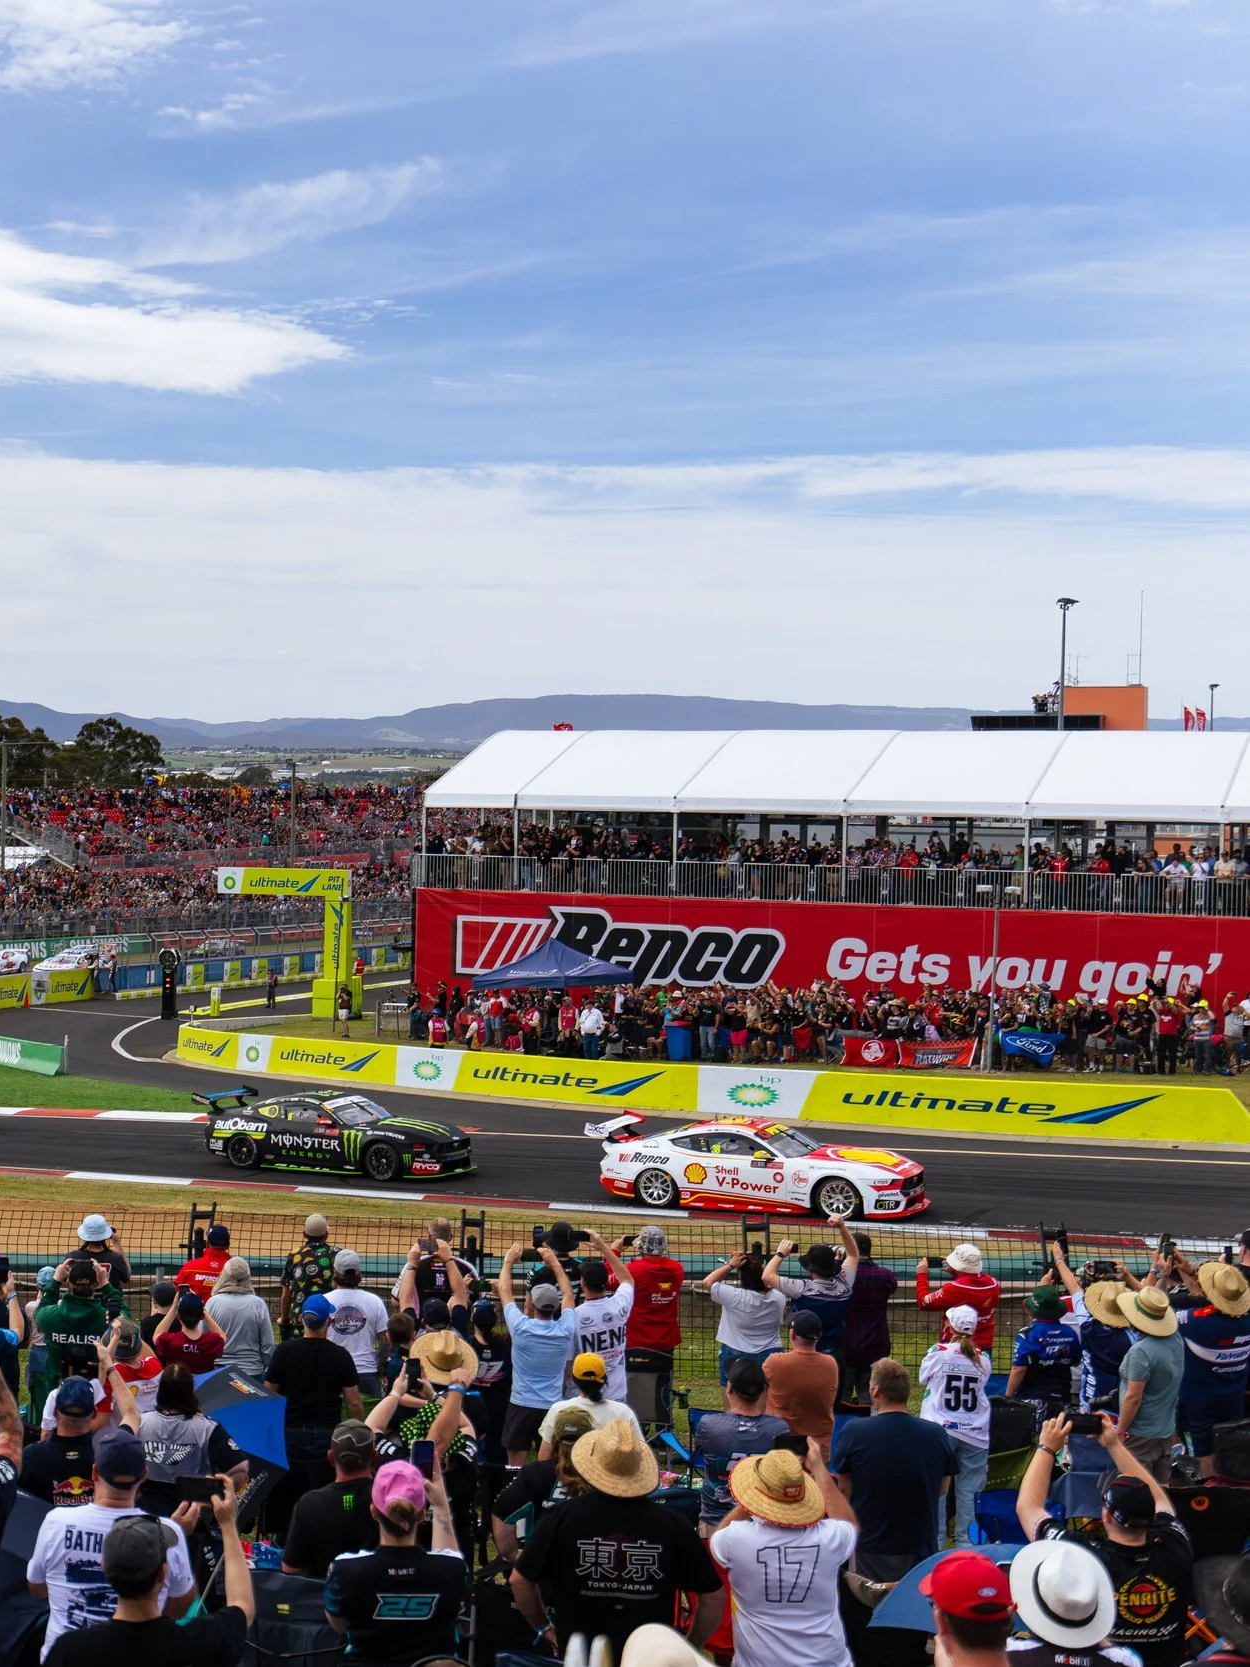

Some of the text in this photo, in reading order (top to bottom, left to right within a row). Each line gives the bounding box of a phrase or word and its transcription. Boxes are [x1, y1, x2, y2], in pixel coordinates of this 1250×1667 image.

[250, 877, 299, 889] ultimate
[327, 875, 340, 883] PIT
[321, 883, 343, 891] LANE
[549, 905, 786, 990] Repco
[826, 937, 1223, 1001] Gets you goin'
[51, 980, 79, 994] ultimate
[182, 1037, 214, 1052] ultimate
[1016, 1038, 1048, 1054] Ford
[279, 1048, 346, 1067] ultimate
[431, 1053, 444, 1062] bp
[473, 1065, 598, 1090] ultimate
[759, 1075, 781, 1085] bp
[841, 1089, 1057, 1117] ultimate
[270, 1132, 340, 1152] MONSTER
[281, 1149, 331, 1159] ENERGY
[630, 1152, 670, 1165] Repco
[412, 1162, 440, 1171] RYCO
[715, 1165, 739, 1176] Shell
[716, 1175, 779, 1194] V-Power
[876, 1200, 897, 1210] OTR
[195, 1274, 219, 1283] SUPERC
[182, 1343, 200, 1353] CAL
[943, 1374, 980, 1413] 55
[53, 1493, 95, 1505] Red Bu
[575, 1537, 663, 1581] 東京
[757, 1545, 820, 1603] 17
[587, 1581, 653, 1591] TOKYO-JAPAN
[1114, 1588, 1178, 1606] PENRITE
[378, 1596, 433, 1618] 25
[1054, 1654, 1081, 1666] Mobil
